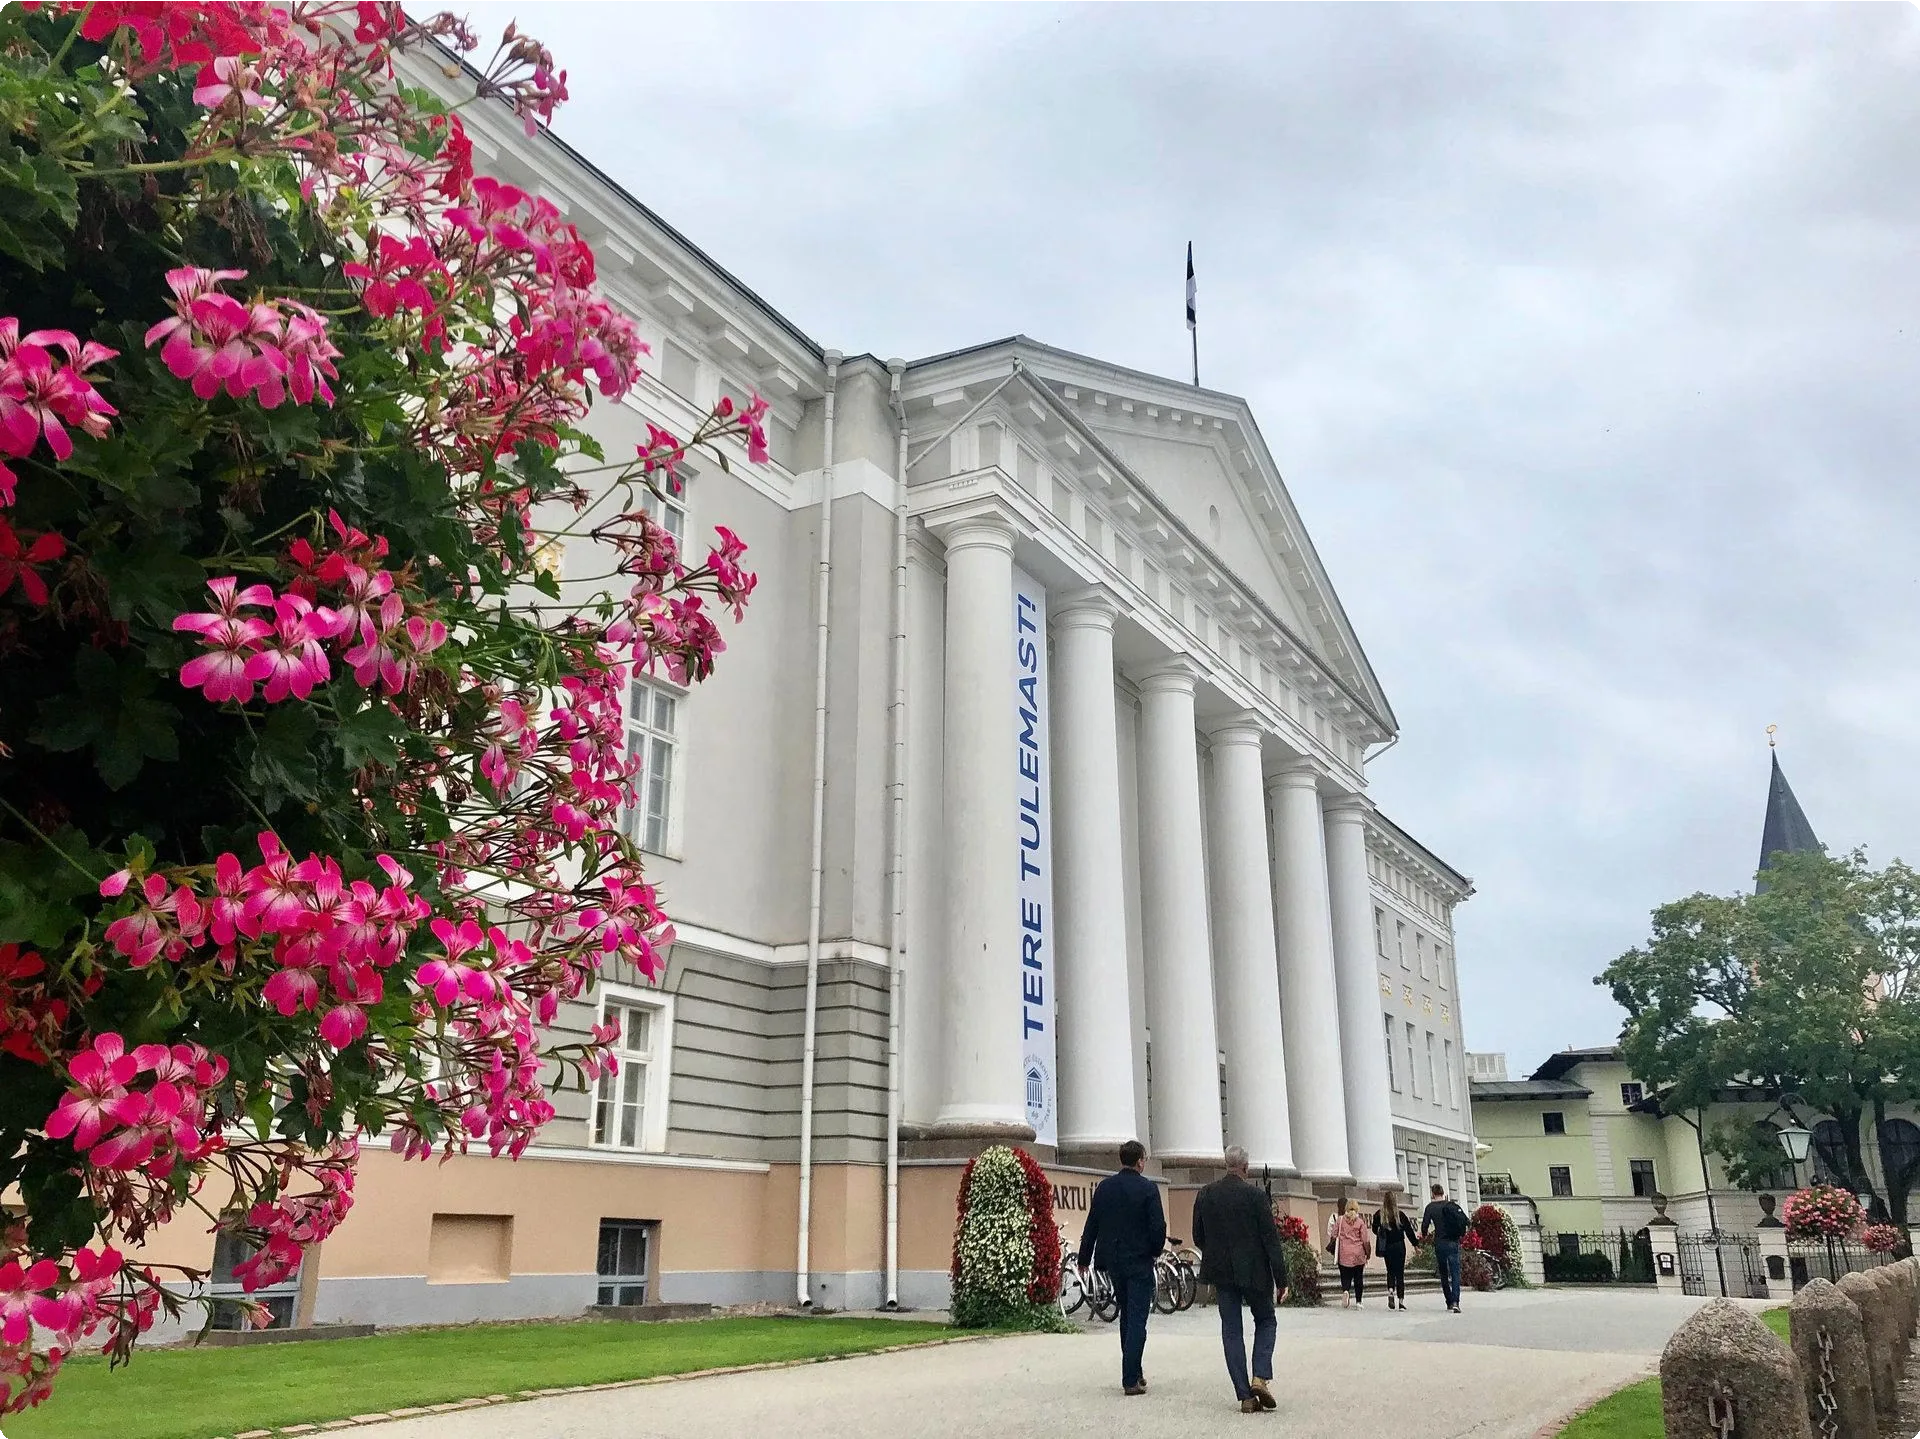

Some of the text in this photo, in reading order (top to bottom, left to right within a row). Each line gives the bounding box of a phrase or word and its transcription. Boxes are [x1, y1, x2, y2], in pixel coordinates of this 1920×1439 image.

[1017, 593, 1041, 882] TULEMAST!
[1021, 897, 1044, 1040] TERE
[1051, 1183, 1087, 1211] ARTU
